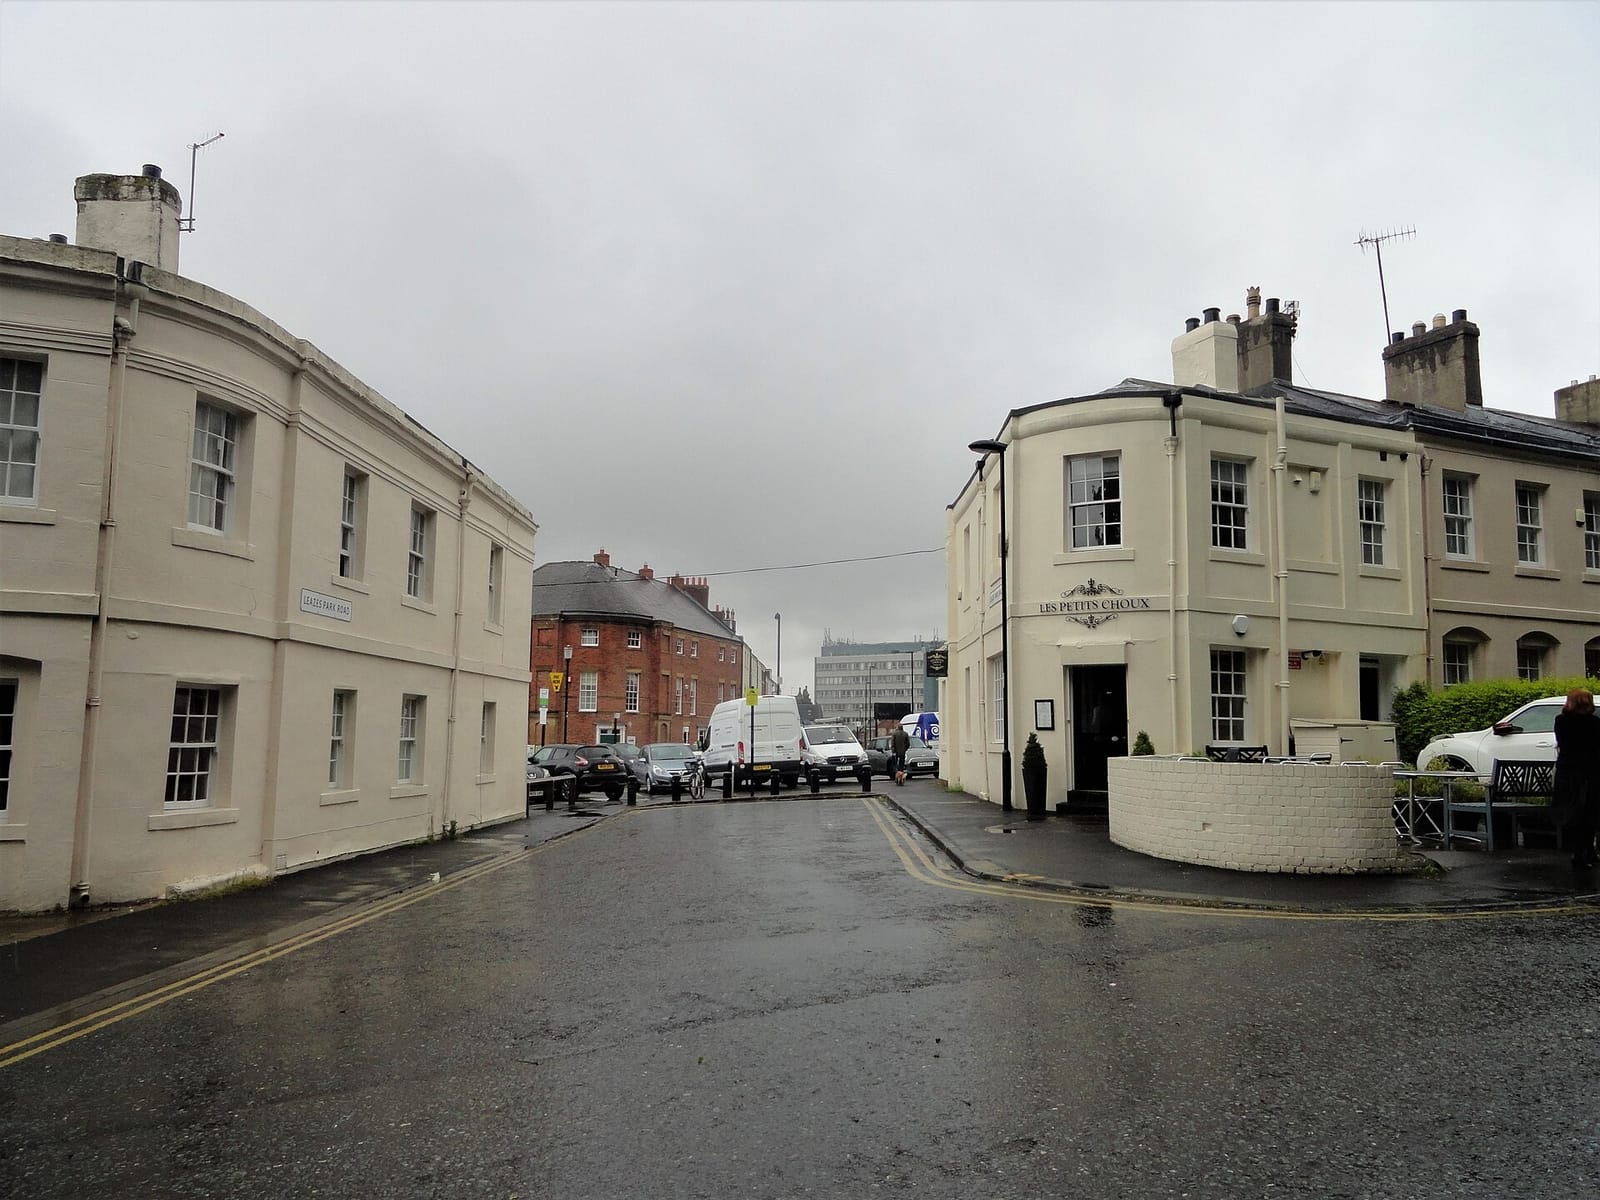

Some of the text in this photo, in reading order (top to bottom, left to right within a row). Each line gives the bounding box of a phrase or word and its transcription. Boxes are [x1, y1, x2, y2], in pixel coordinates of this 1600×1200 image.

[303, 595, 350, 616] LEAZES PARK ROAD
[1040, 598, 1150, 613] LES PETITS CHOUX
